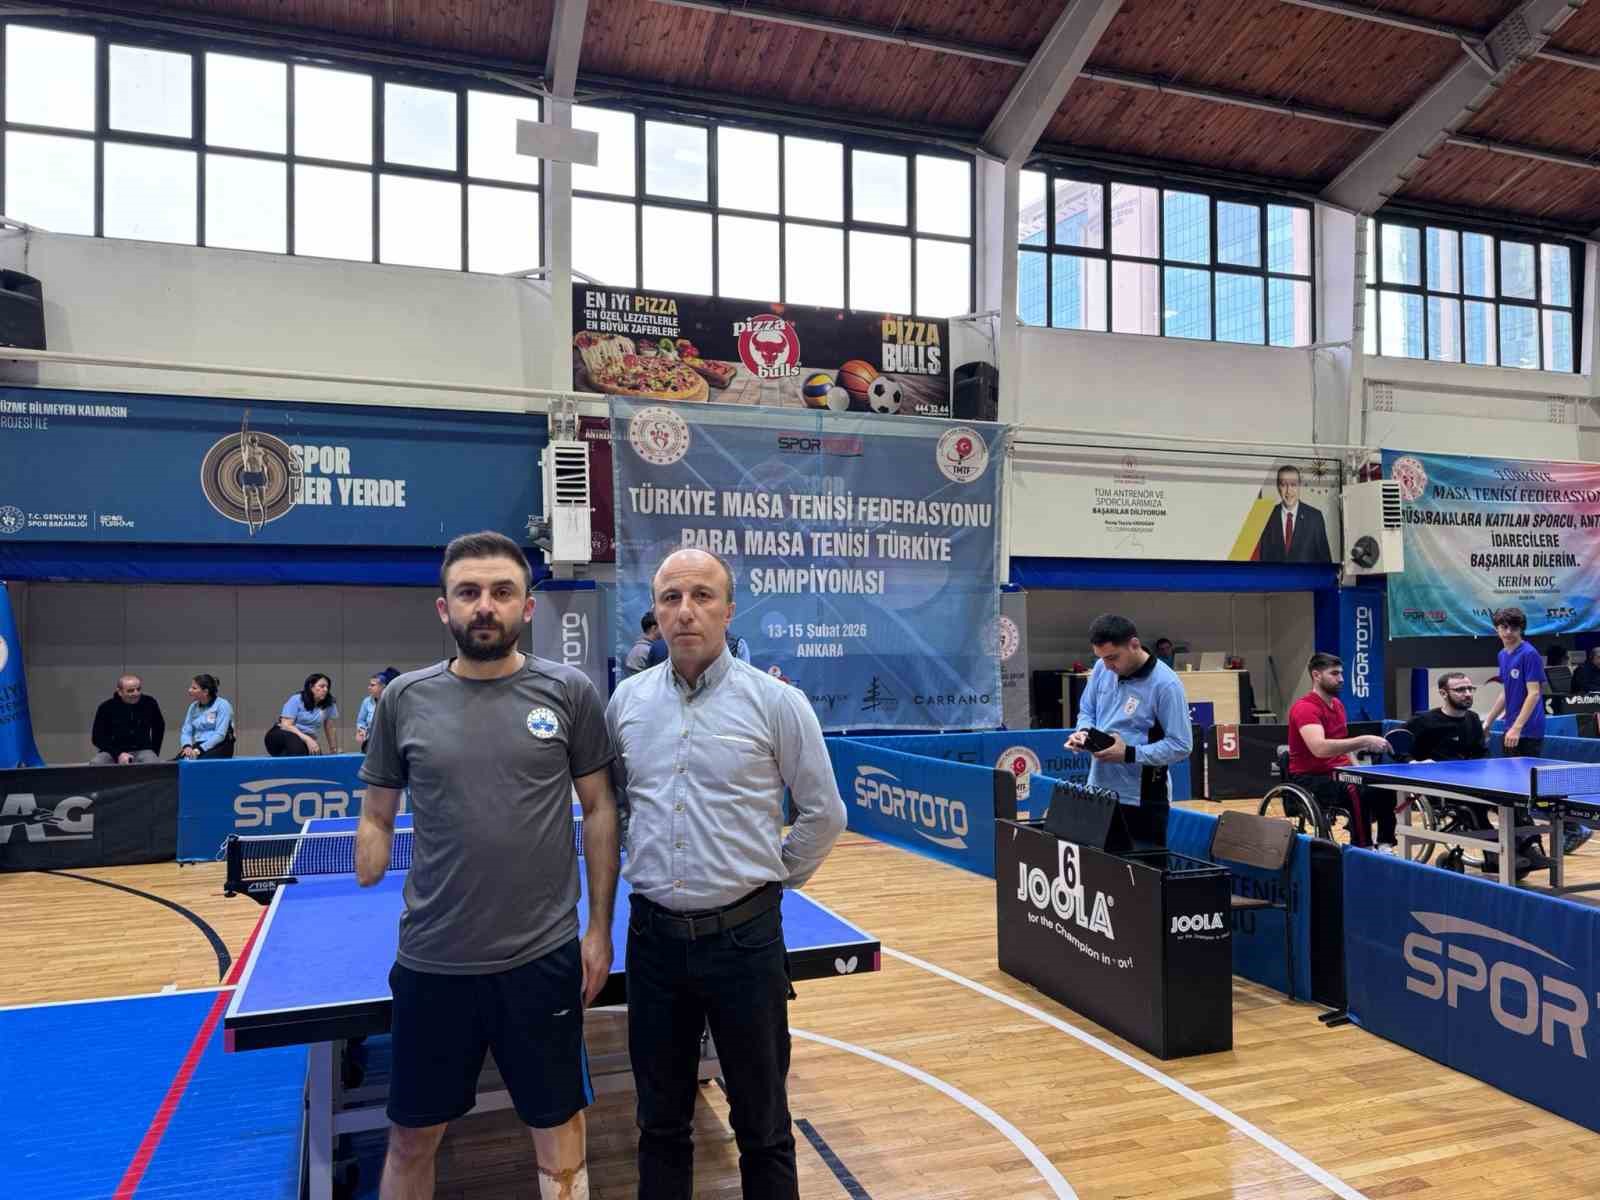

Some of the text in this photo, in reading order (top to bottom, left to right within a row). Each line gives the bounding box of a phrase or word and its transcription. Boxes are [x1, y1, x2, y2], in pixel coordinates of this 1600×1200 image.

[586, 291, 606, 309] EN
[600, 309, 624, 321] ÖZEL
[586, 320, 598, 330] EN
[600, 319, 629, 333] BÜYÜK
[733, 317, 786, 336] pizza
[882, 342, 941, 375] BULLS
[758, 363, 800, 378] bulls
[29, 401, 76, 416] BİLMEYEN
[78, 405, 128, 418] KALMASIN
[288, 444, 350, 474] SPOR
[288, 476, 406, 507] HER YERDE
[1432, 485, 1471, 501] MASA
[1473, 484, 1518, 502] TENİSİ
[628, 483, 992, 527] TÜRKİYE MASA TENİSİ FEDERASYONU
[1485, 511, 1530, 528] KATILAN
[1532, 512, 1577, 530] SPORCU,
[681, 528, 952, 561] PARA MASA TENİSİ TÜRKİYE
[1491, 530, 1560, 548] İDARECİLERE
[1470, 551, 1581, 572] BAŞARILAR DİLERİM.
[750, 564, 885, 596] ŞAMPİYONASI
[1498, 574, 1556, 590] KERİM KOÇ
[768, 623, 867, 639] 13-15 Şubat 2026
[796, 643, 844, 657] ANKARA
[1357, 606, 1370, 698] SPORTOTO
[914, 695, 990, 705] CARRANO
[1222, 732, 1236, 751] 5
[1046, 755, 1090, 770] TÜRKİY
[854, 776, 969, 836] SPORTOTO
[1063, 846, 1076, 890] 6
[1017, 862, 1115, 940] JOOLA
[1171, 912, 1222, 933] JOOLA
[1028, 912, 1039, 923] for
[1040, 914, 1054, 929] the
[1055, 922, 1100, 961] Champion
[1101, 952, 1111, 966] in
[1403, 932, 1600, 1059] SPOR
